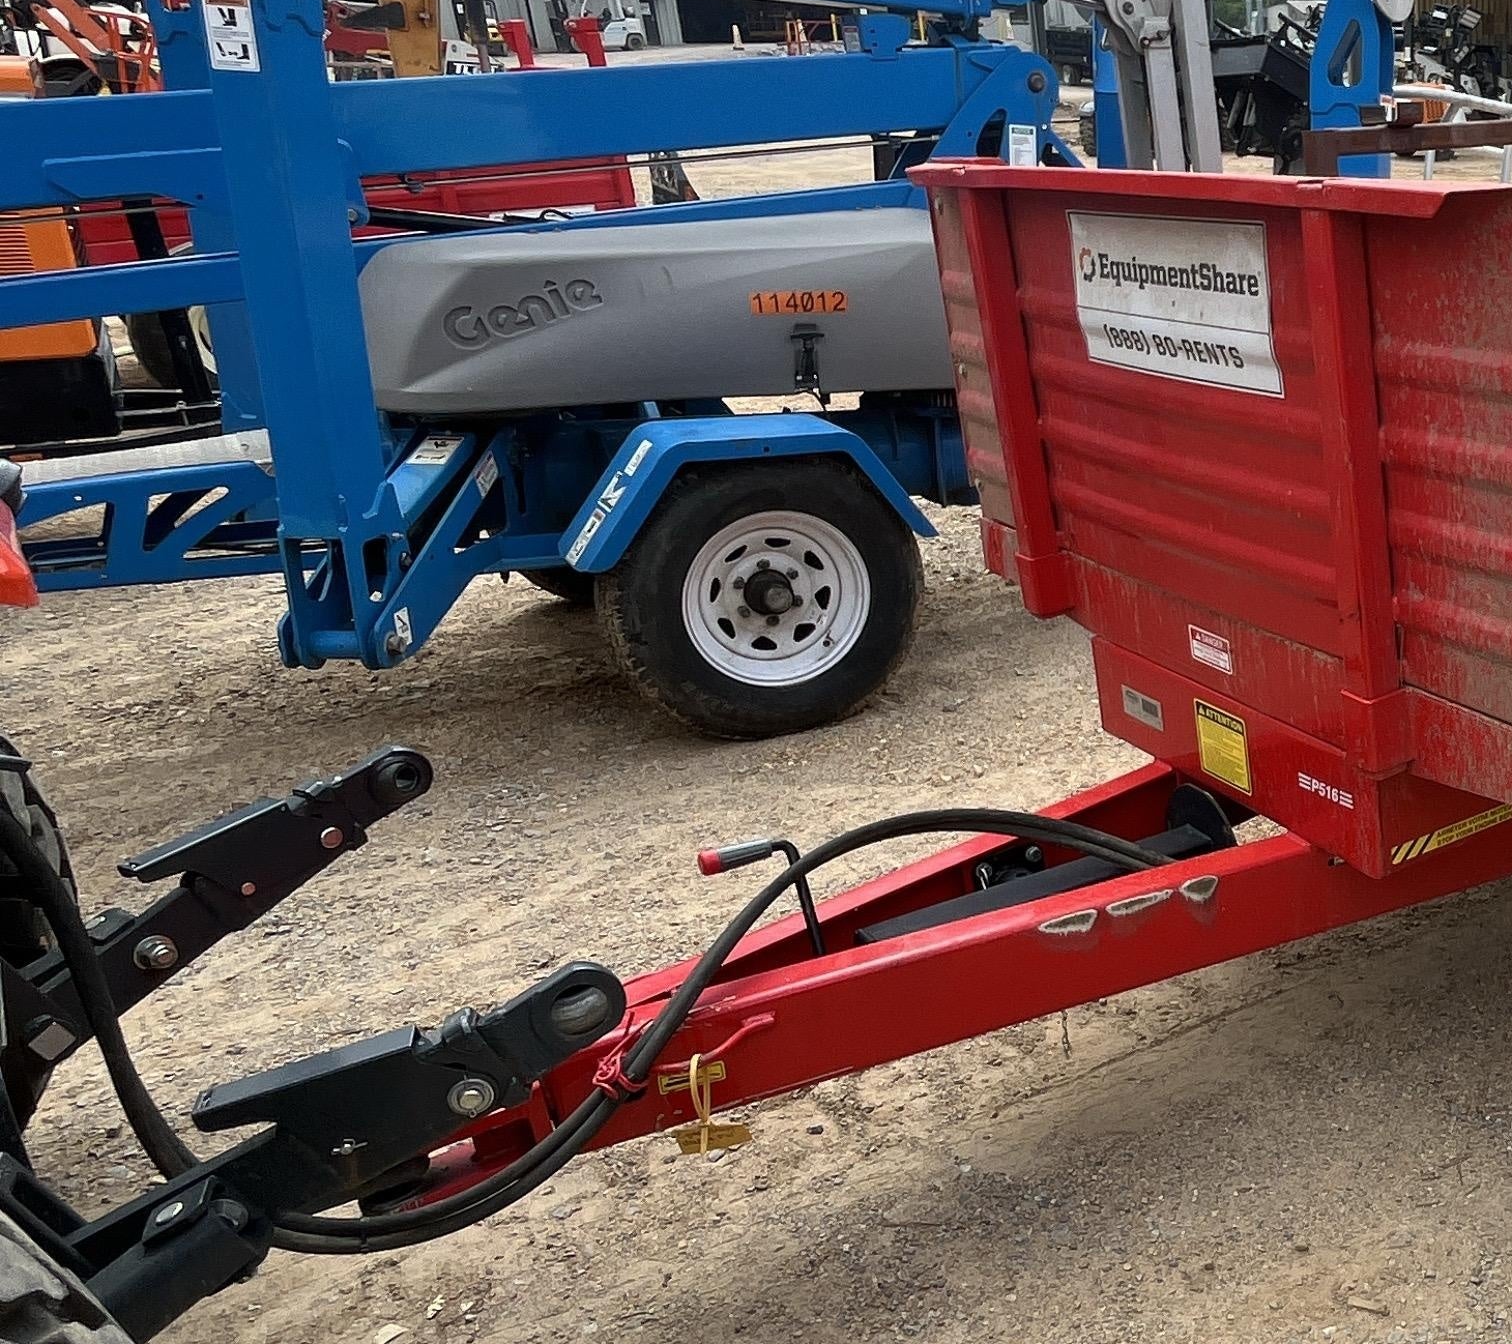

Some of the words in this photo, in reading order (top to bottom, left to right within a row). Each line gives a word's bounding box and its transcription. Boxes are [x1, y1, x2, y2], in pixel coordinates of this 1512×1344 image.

[1098, 252, 1260, 297] EquipmentShare
[442, 278, 604, 351] Genie
[751, 290, 847, 313] 114012
[1103, 323, 1151, 355] (888)
[1152, 334, 1245, 369] 80-RENTS
[1311, 778, 1339, 802] P516
